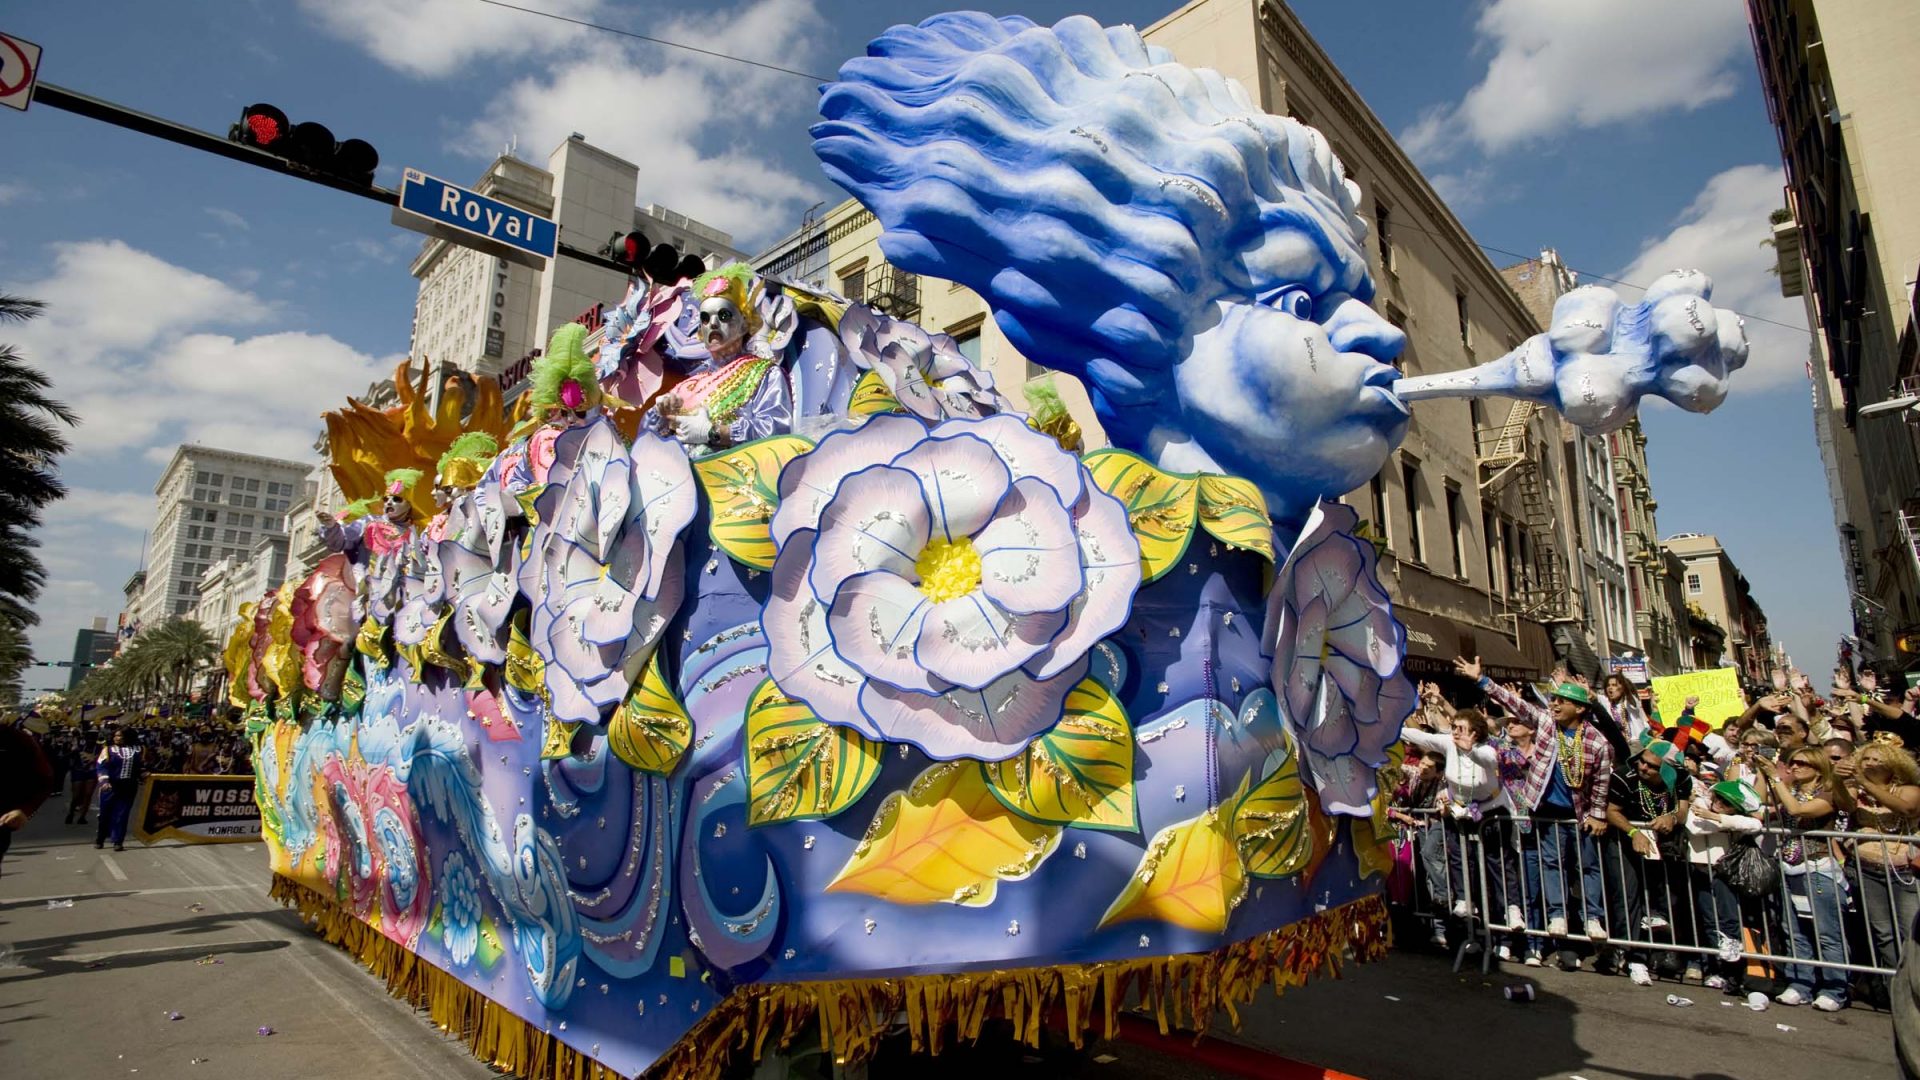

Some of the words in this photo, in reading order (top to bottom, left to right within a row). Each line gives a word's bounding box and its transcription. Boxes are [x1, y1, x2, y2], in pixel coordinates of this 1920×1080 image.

[440, 185, 535, 241] Royal
[181, 806, 210, 816] HIGH
[213, 805, 259, 816] SCHOOL
